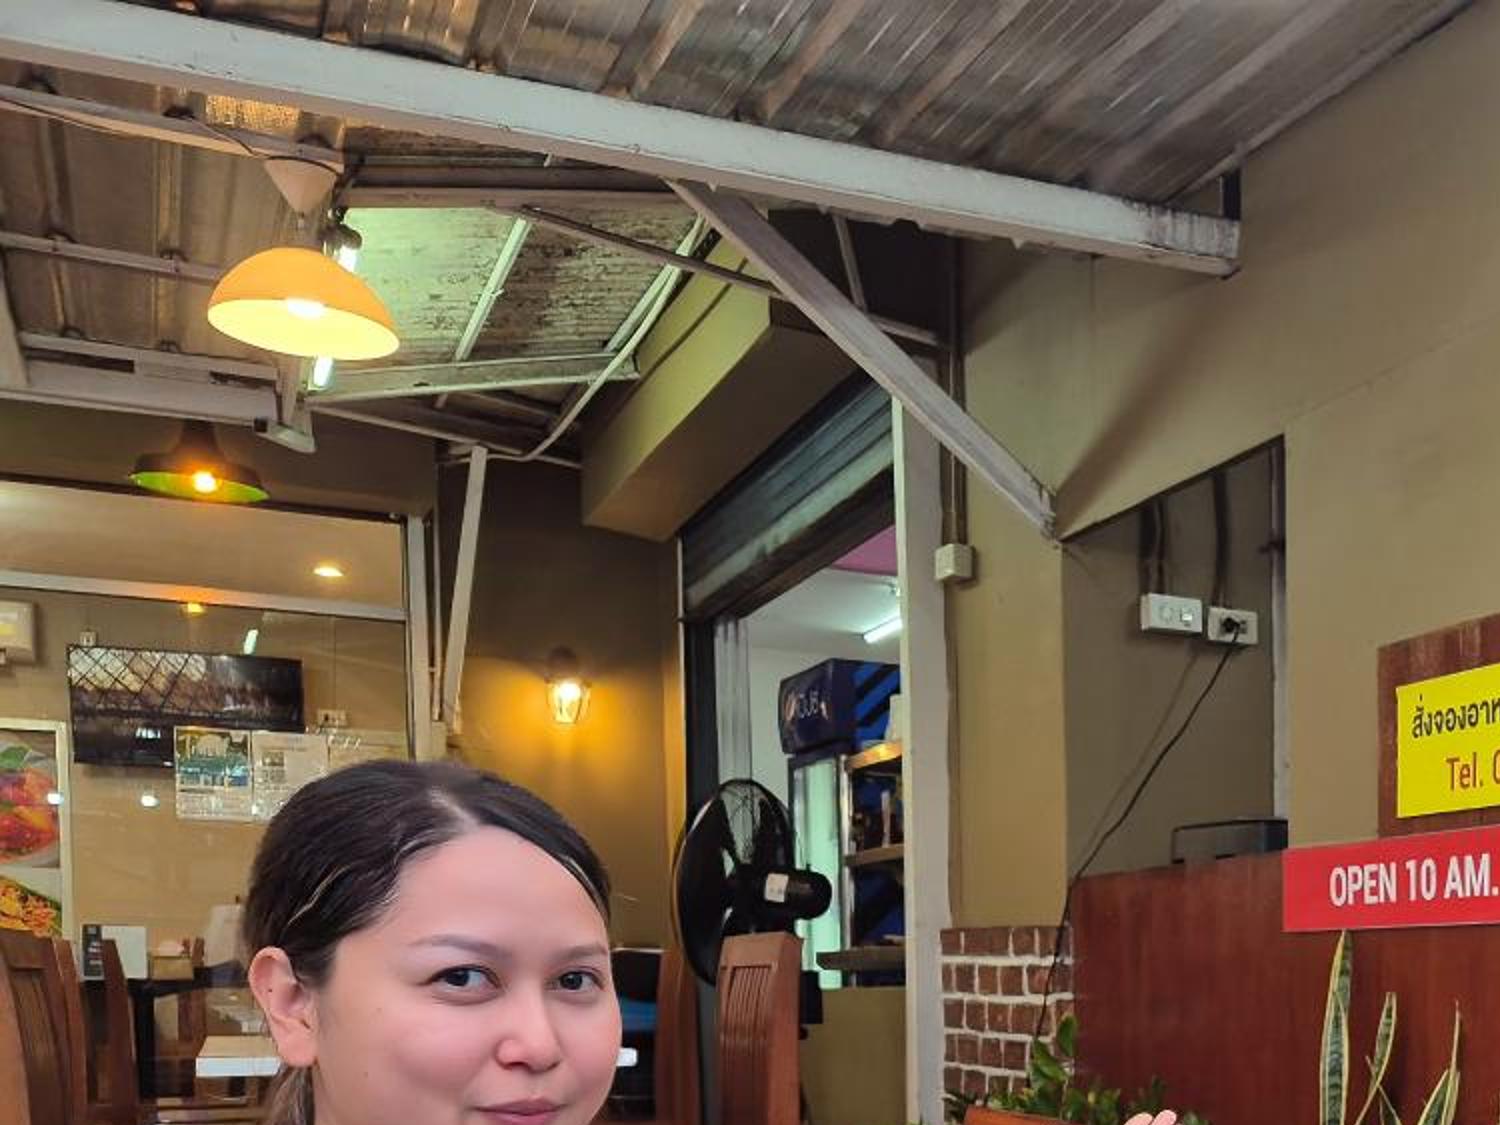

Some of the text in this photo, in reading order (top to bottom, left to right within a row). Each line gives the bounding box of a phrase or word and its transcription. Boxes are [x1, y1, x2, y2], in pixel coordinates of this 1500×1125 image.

[1446, 752, 1484, 791] Tel.
[1329, 861, 1398, 907] OPEN
[1405, 857, 1438, 902] 10
[1443, 852, 1500, 899] AM.
